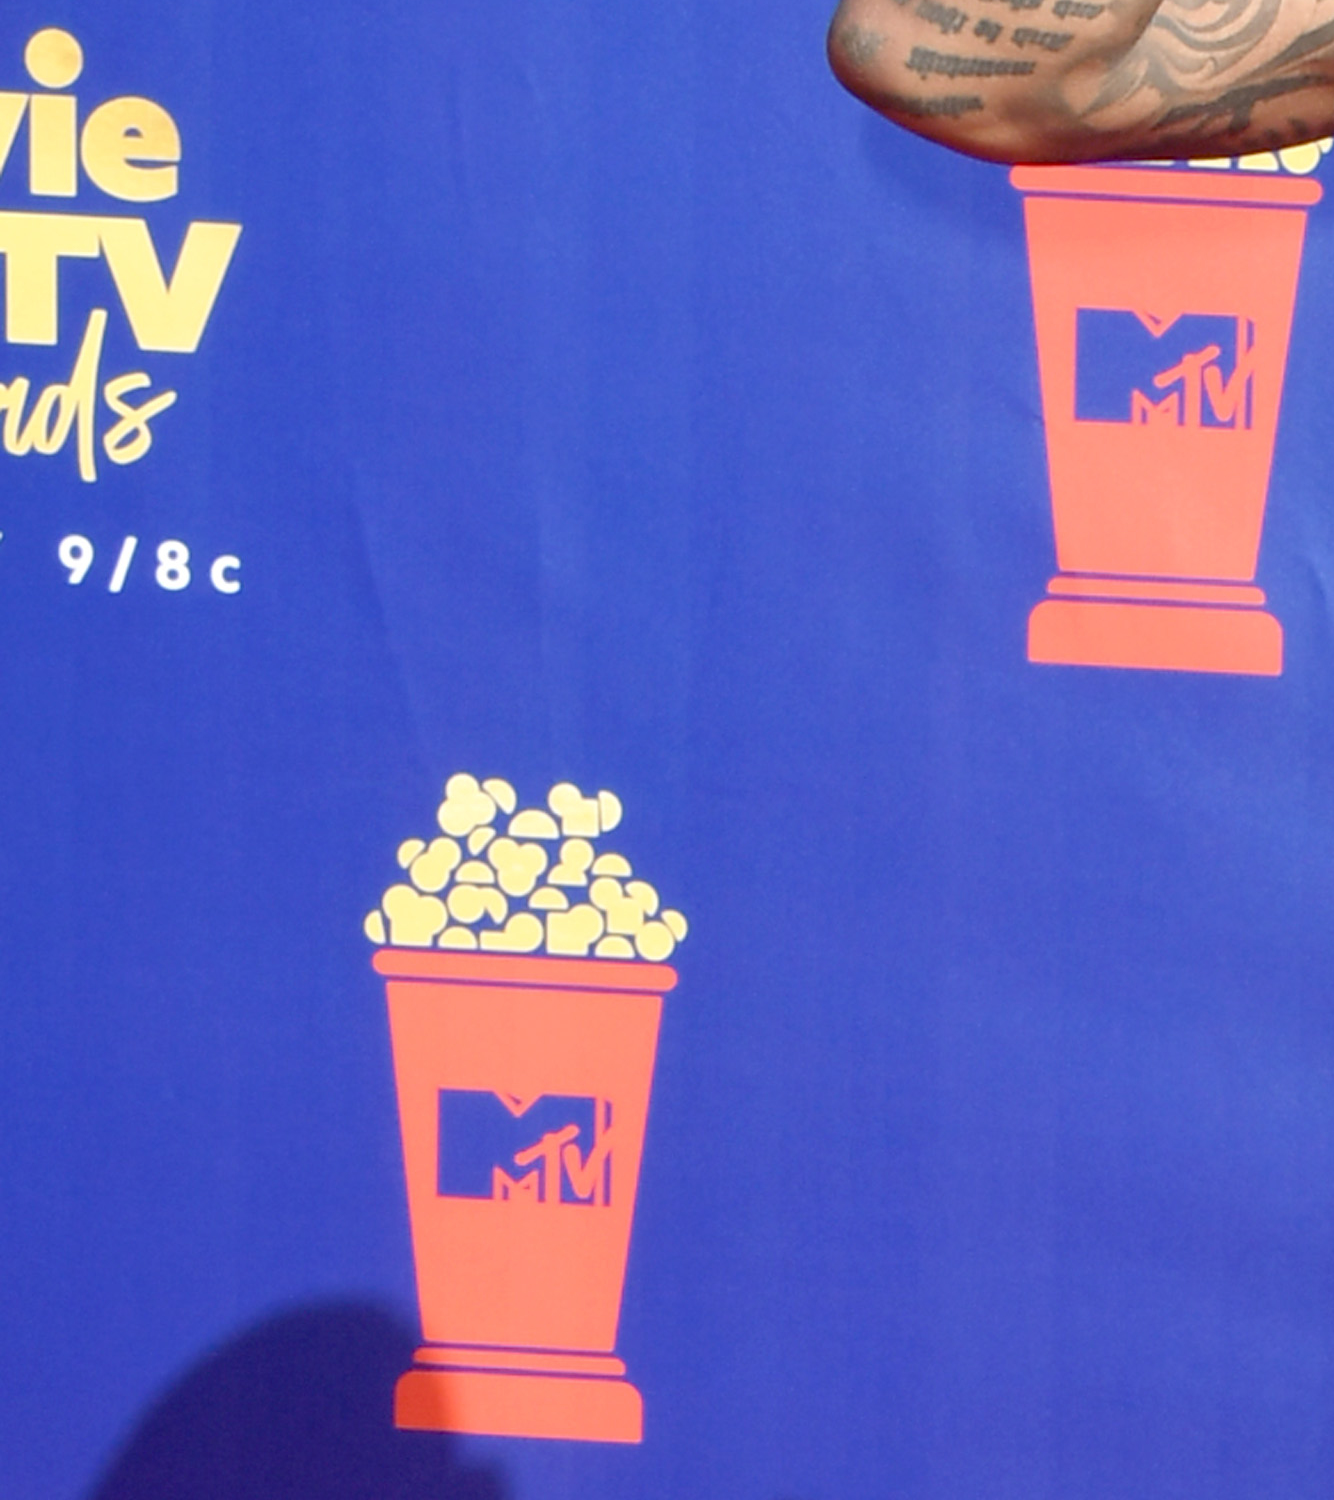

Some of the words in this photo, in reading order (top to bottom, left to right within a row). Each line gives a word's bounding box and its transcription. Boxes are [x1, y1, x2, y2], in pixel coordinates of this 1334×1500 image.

[0, 212, 242, 353] TV
[1074, 307, 1254, 430] MTV
[57, 534, 241, 595] 9/8c
[436, 1086, 612, 1207] MTV
